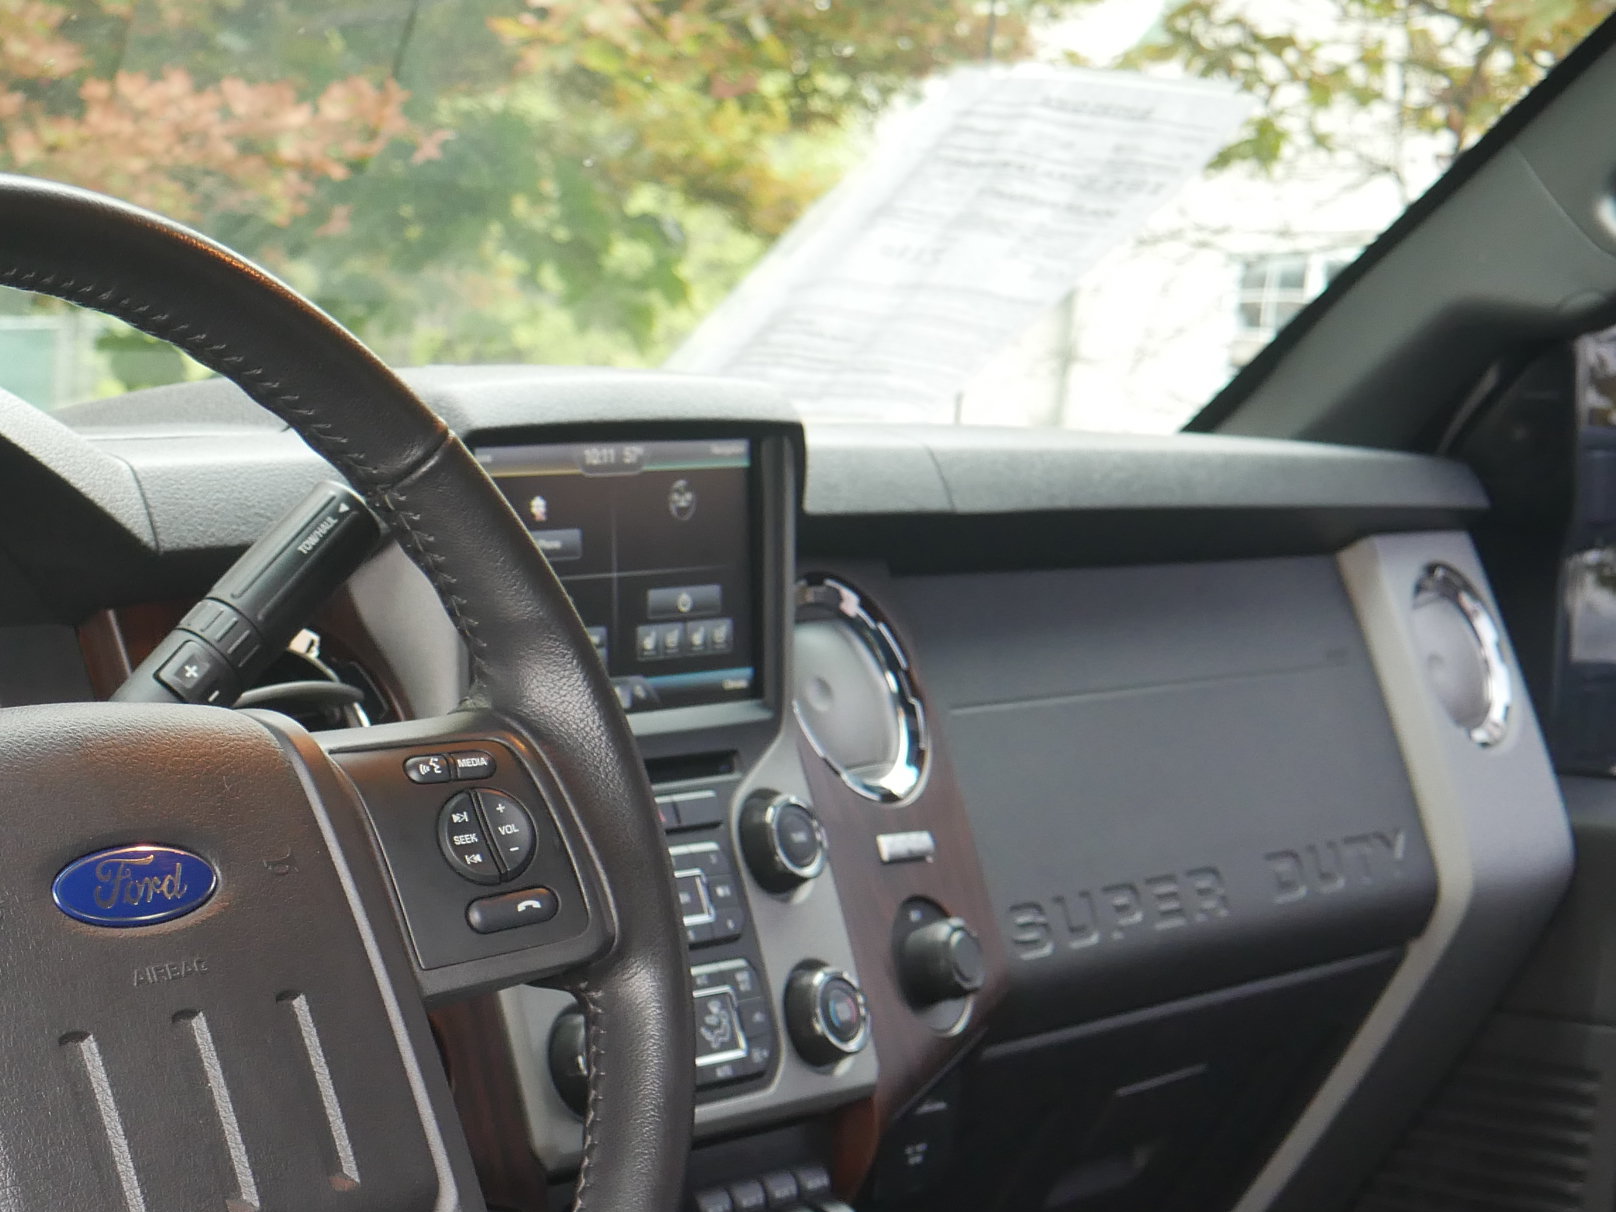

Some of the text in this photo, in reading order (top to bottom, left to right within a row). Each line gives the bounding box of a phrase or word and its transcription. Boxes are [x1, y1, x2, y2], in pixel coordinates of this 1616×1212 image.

[457, 757, 488, 768] MEDIA
[453, 832, 479, 846] SEEK
[498, 823, 520, 836] VOL
[94, 854, 188, 909] Ford
[1008, 828, 1406, 961] SUPER DUTY
[133, 957, 209, 987] AIRBAG
